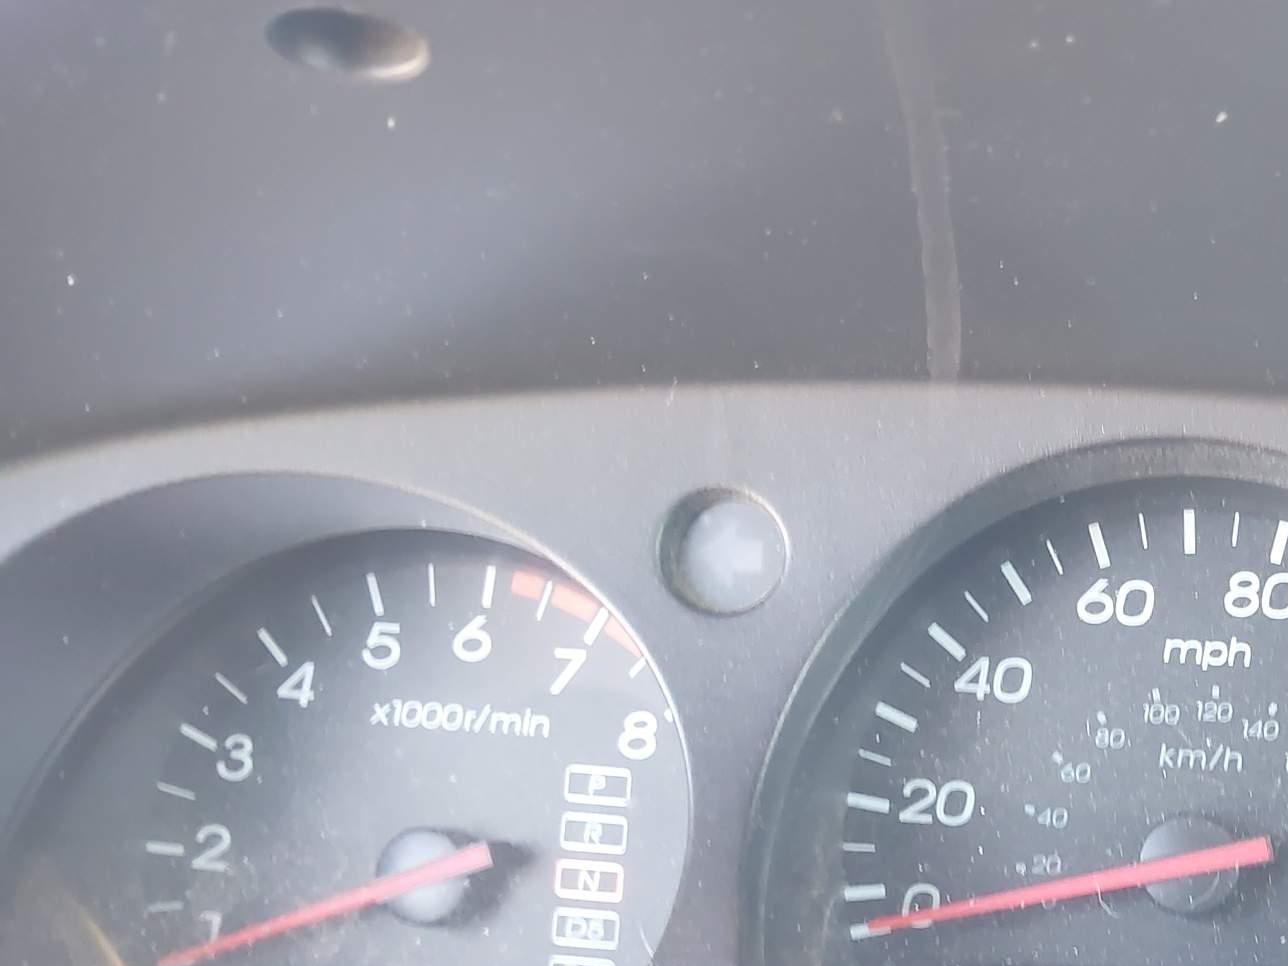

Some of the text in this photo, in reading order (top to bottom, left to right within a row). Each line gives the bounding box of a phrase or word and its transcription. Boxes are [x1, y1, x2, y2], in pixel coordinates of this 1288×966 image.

[1076, 578, 1154, 626] 60
[362, 622, 401, 670] 5
[453, 615, 493, 662] 6
[1164, 637, 1251, 669] mph
[278, 662, 315, 708] 4
[550, 649, 586, 696] 7
[954, 657, 1033, 704] 40
[370, 700, 550, 737] x1000r/min
[1143, 703, 1180, 726] 100
[1197, 701, 1233, 723] 120
[1242, 718, 1280, 741] 140
[617, 710, 658, 760] 8
[1095, 727, 1125, 749] 80
[216, 733, 253, 781] 3
[1061, 762, 1091, 784] 60
[1159, 743, 1243, 773] km/h
[900, 779, 975, 826] 20
[1037, 807, 1068, 829] 40
[192, 824, 231, 872] 2
[1031, 854, 1061, 876] 20
[578, 868, 600, 893] N
[902, 882, 941, 929] 0
